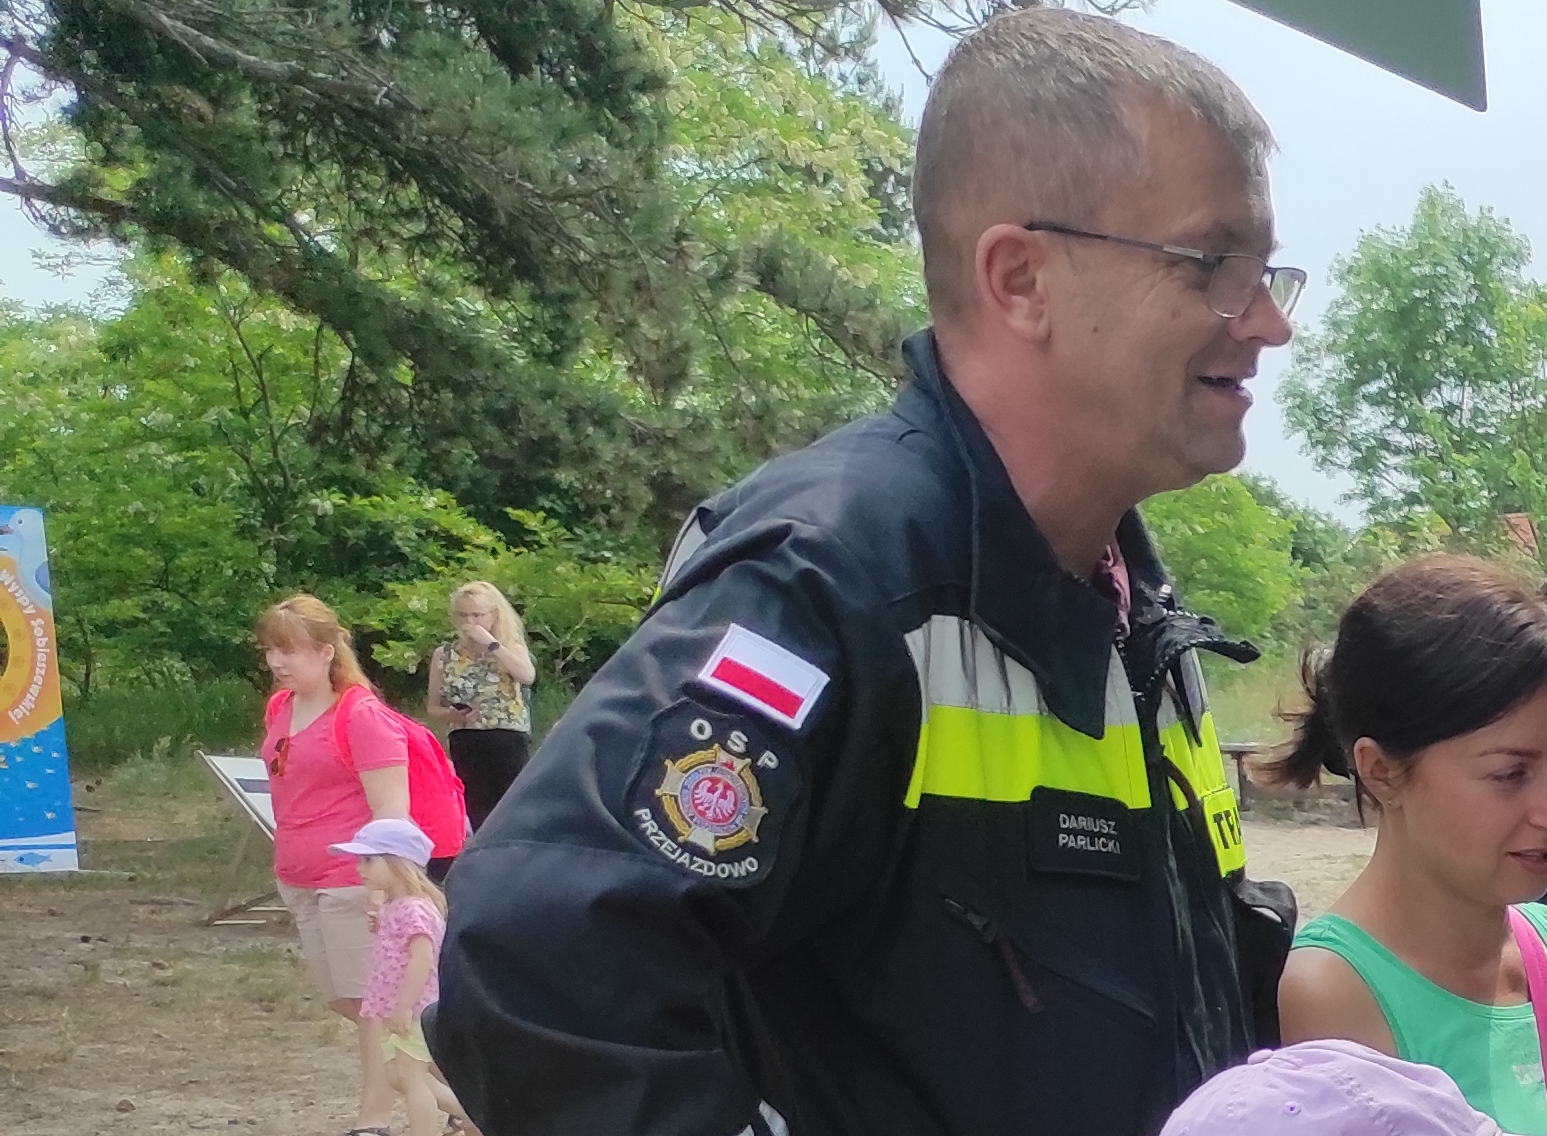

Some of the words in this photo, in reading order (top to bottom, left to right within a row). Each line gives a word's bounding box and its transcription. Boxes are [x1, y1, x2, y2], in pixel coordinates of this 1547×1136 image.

[690, 718, 780, 770] OSP
[634, 807, 759, 878] PRZEJAZDOWO
[1059, 813, 1118, 836] DARIUSZ
[1058, 833, 1121, 855] PARLICKI
